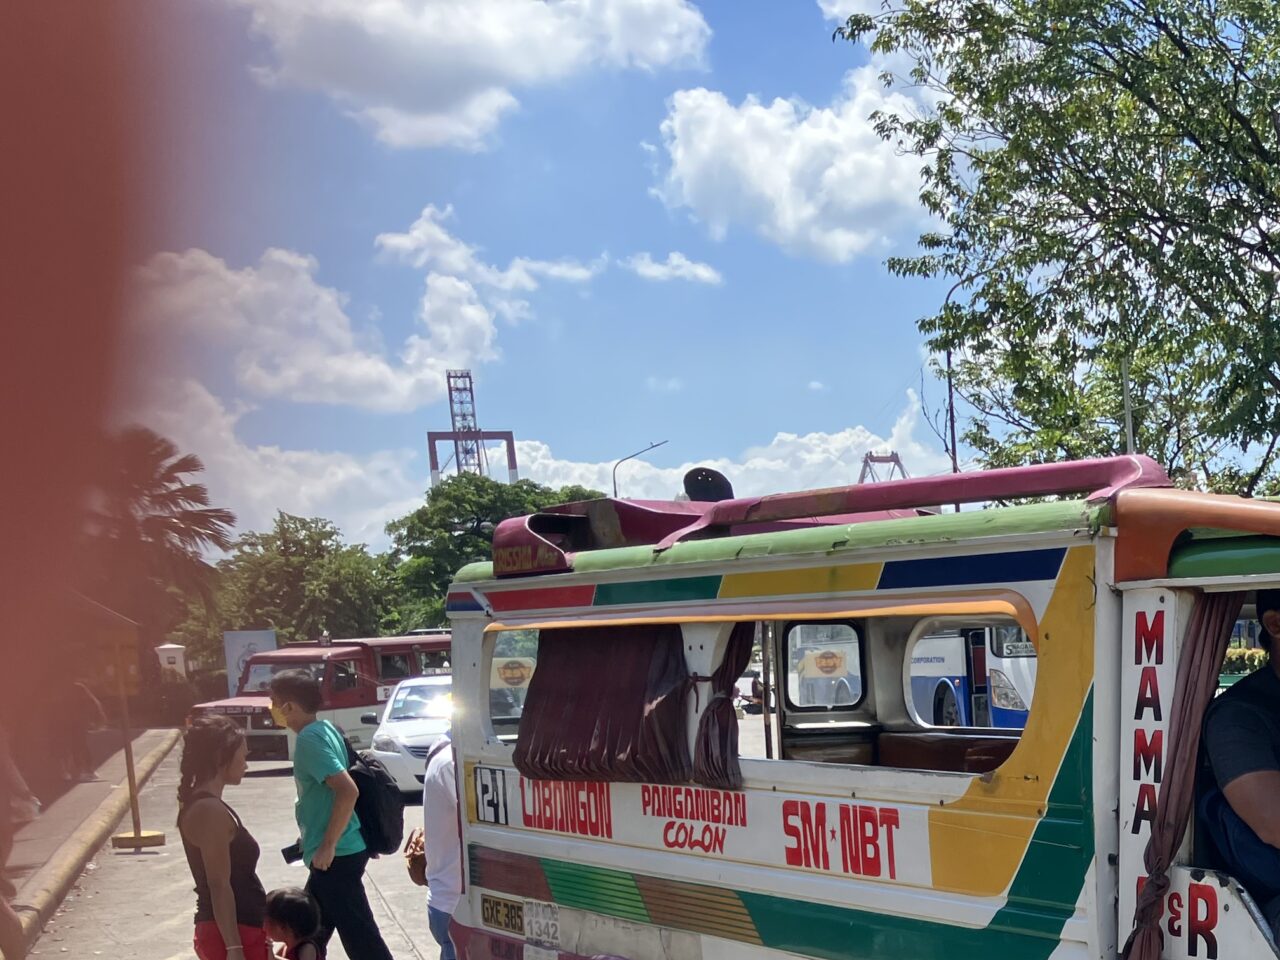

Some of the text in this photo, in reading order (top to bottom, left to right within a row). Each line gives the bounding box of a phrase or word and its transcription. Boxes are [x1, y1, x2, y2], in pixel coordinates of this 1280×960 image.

[641, 784, 748, 827] PANGANIBAN
[663, 821, 727, 854] COLON
[782, 799, 900, 880] SM NBT
[482, 898, 503, 927] GXE
[504, 902, 523, 932] 385
[526, 919, 559, 941] 1342
